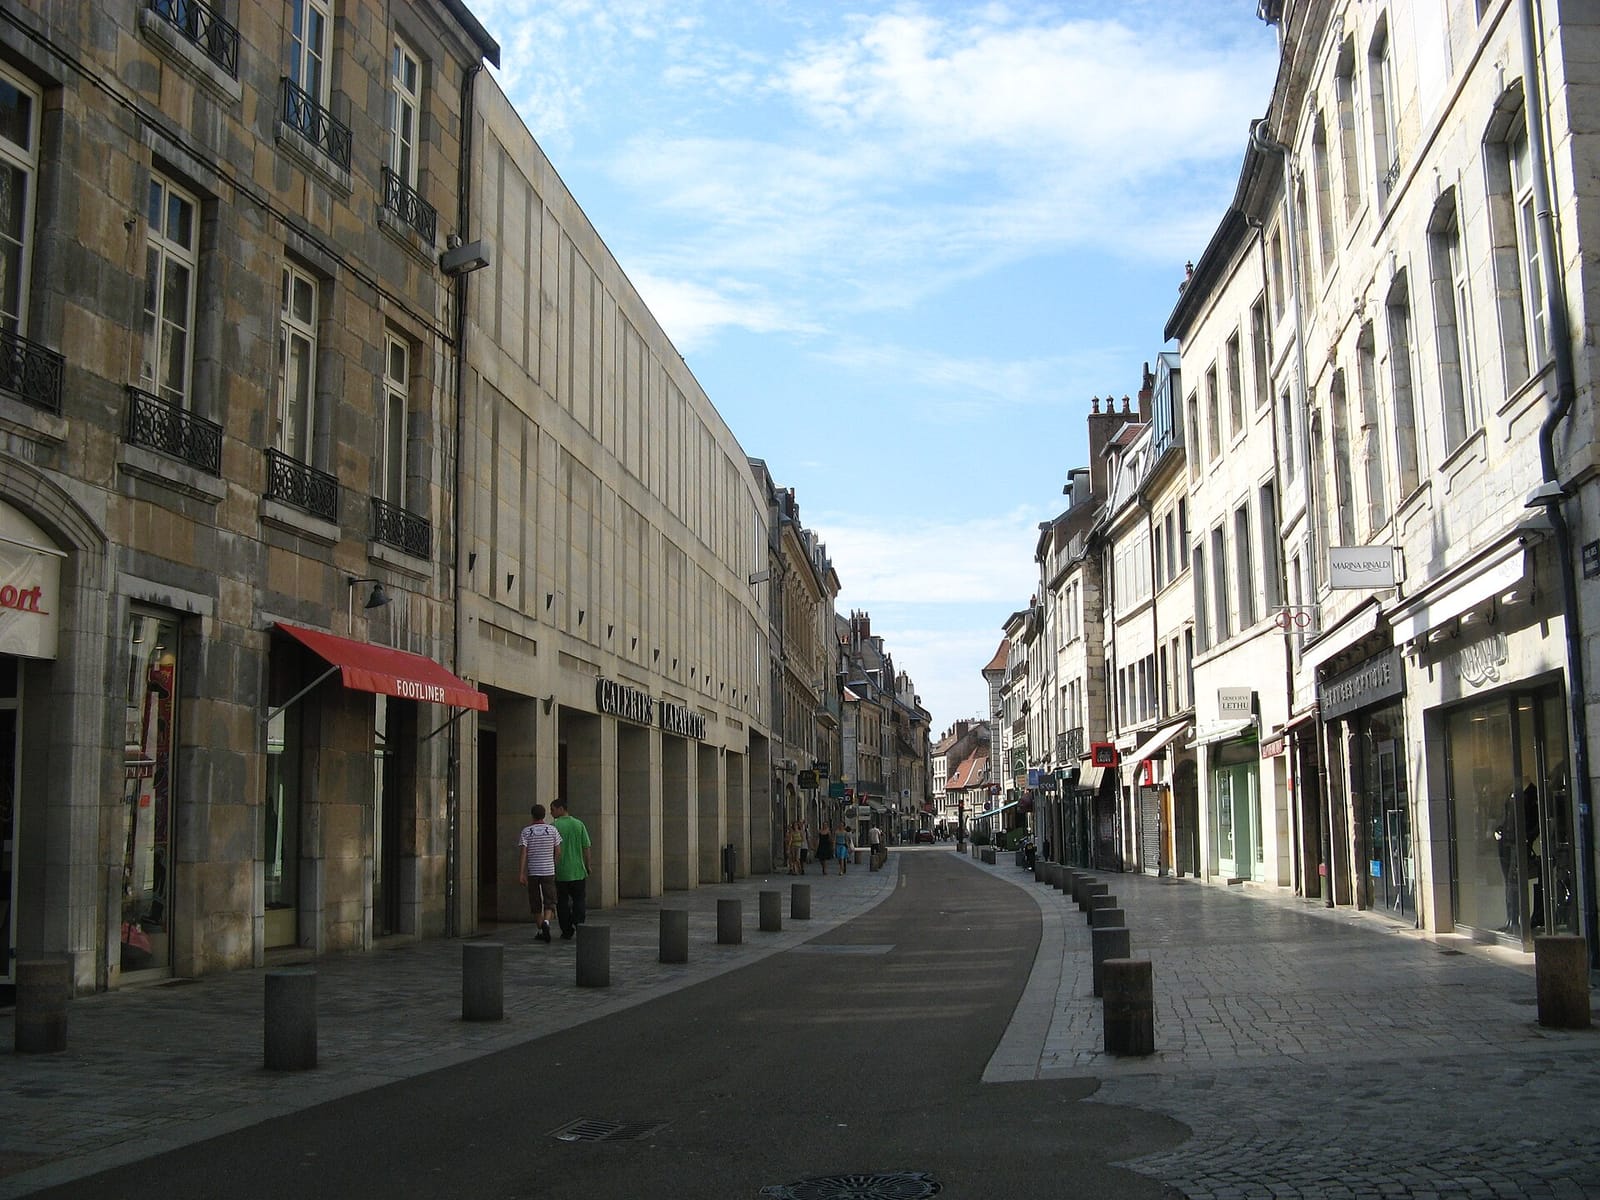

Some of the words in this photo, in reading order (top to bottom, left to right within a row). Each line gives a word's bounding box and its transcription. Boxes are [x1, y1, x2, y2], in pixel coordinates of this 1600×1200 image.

[1333, 561, 1361, 571] MARINA
[1362, 561, 1391, 571] RINALDI
[396, 679, 446, 703] FOOTLINER
[597, 678, 653, 725] GALERIES
[660, 700, 706, 740] LAFAYETTE
